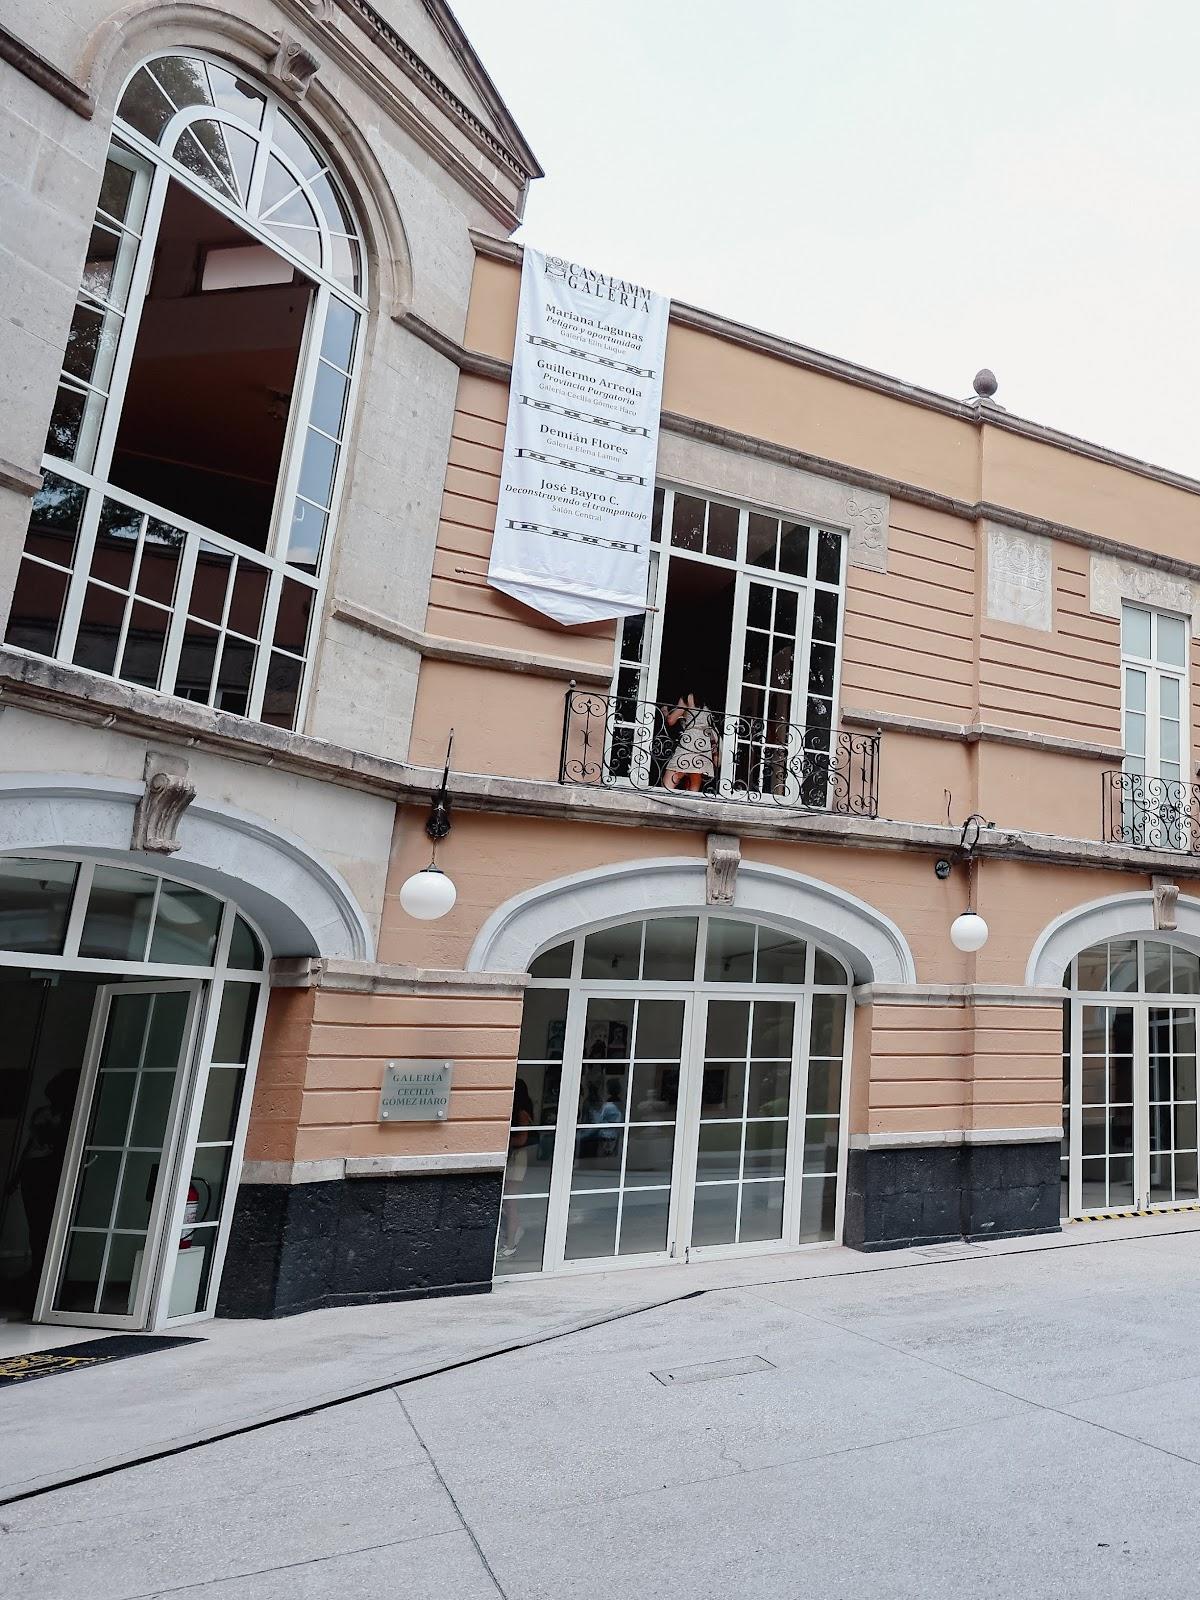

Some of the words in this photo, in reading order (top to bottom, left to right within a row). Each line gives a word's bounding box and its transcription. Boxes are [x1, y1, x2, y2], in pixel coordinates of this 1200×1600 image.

[569, 263, 606, 286] CASA
[609, 277, 651, 300] LAMM
[545, 303, 595, 327] Mariana
[597, 320, 644, 342] Lagunas
[546, 315, 578, 331] Peligro
[579, 326, 586, 334] y
[587, 328, 642, 351] oportunidad
[604, 343, 626, 355] Luque
[537, 359, 596, 384] Guillermo
[599, 378, 642, 397] Arreola
[543, 372, 586, 391] Provincia
[587, 386, 635, 406] Purgatorio
[567, 391, 592, 403] Cecilia
[619, 406, 637, 417] Haro
[539, 424, 588, 445] Demián
[592, 438, 629, 455] Flores
[575, 445, 596, 457] Elena
[597, 451, 621, 463] Lamm
[505, 484, 580, 506] Deconstruyendo
[582, 501, 591, 509] el
[592, 502, 647, 521] trampantojo
[540, 479, 567, 493] José
[570, 486, 606, 502] Bayro
[609, 495, 619, 506] C.
[551, 504, 573, 516] Salón
[574, 509, 602, 522] Central
[397, 1088, 435, 1096] CECILIA
[419, 1097, 447, 1105] HARO
